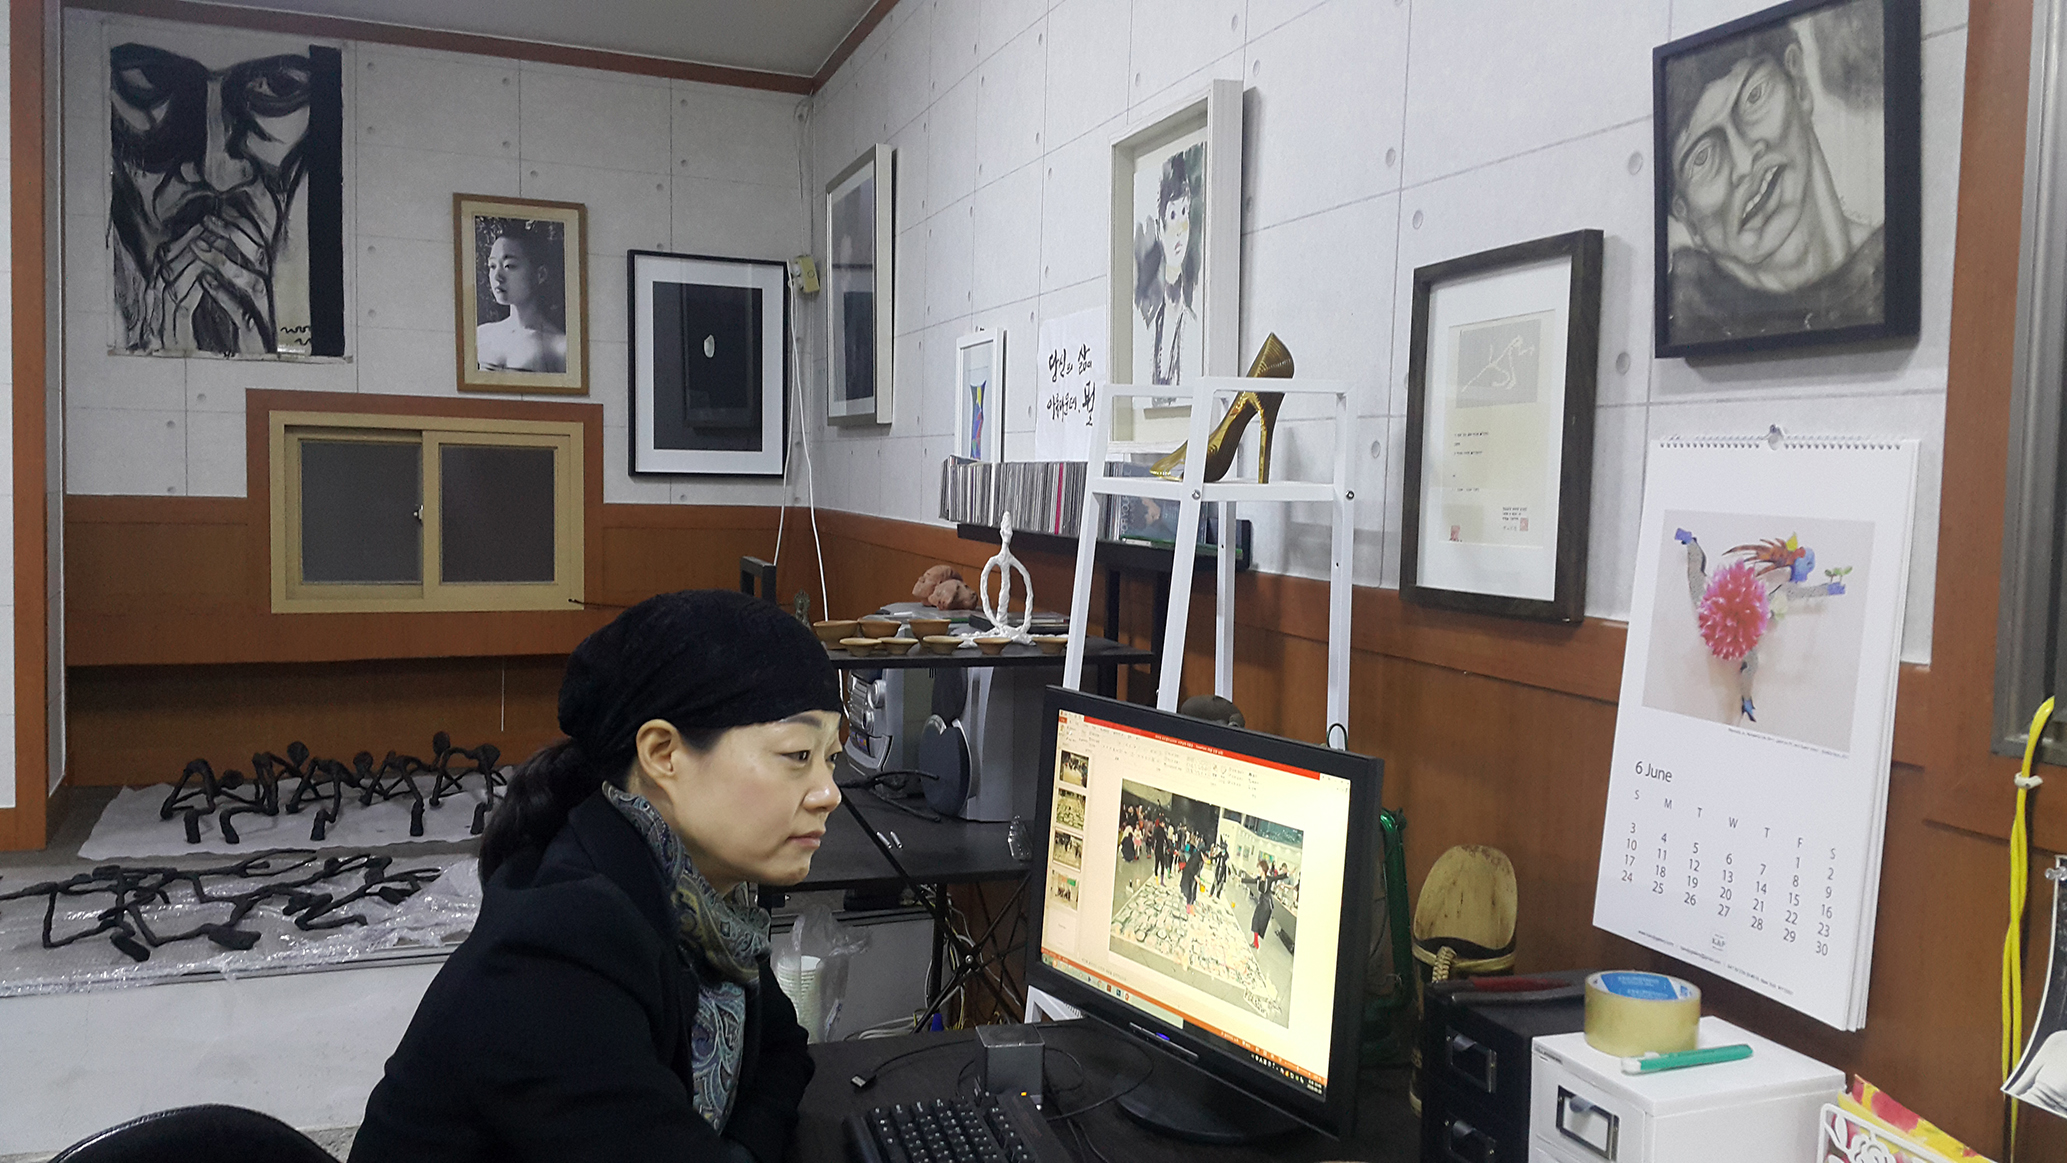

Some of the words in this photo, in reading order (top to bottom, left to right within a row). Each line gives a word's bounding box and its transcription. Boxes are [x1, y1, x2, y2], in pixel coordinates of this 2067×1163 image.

[1635, 760, 1644, 775] 6
[1644, 763, 1673, 783] June
[1629, 821, 1637, 834] 3
[1660, 832, 1668, 844] 4
[1692, 841, 1700, 855] 5
[1725, 852, 1733, 866] 6
[1759, 863, 1767, 876] 7
[1792, 874, 1800, 888] 8
[1825, 885, 1833, 899] 9
[1634, 789, 1640, 801] S
[1663, 797, 1673, 810] M
[1697, 806, 1703, 818] T
[1728, 816, 1739, 829] W
[1764, 826, 1771, 839] T
[1797, 836, 1804, 849] F
[1830, 847, 1836, 860] S
[1624, 854, 1636, 867] 17
[1655, 865, 1667, 879] 18
[1687, 875, 1699, 889] 19
[1719, 886, 1733, 901] 20
[1752, 898, 1765, 913] 21
[1784, 910, 1799, 926] 22
[1817, 922, 1831, 938] 23
[1626, 838, 1638, 852] 10
[1657, 848, 1667, 861] 11
[1689, 859, 1701, 873] 12
[1722, 870, 1734, 884] 13
[1755, 881, 1767, 896] 14
[1788, 892, 1800, 907] 15
[1821, 904, 1833, 920] 16
[1795, 856, 1801, 870] 1
[1827, 866, 1835, 881] 2
[1621, 870, 1633, 884] 24
[1651, 881, 1664, 895] 25
[1683, 892, 1697, 907] 26
[1717, 904, 1731, 918] 27
[1750, 916, 1764, 931] 28
[1782, 928, 1797, 943] 29
[1815, 941, 1829, 957] 30
